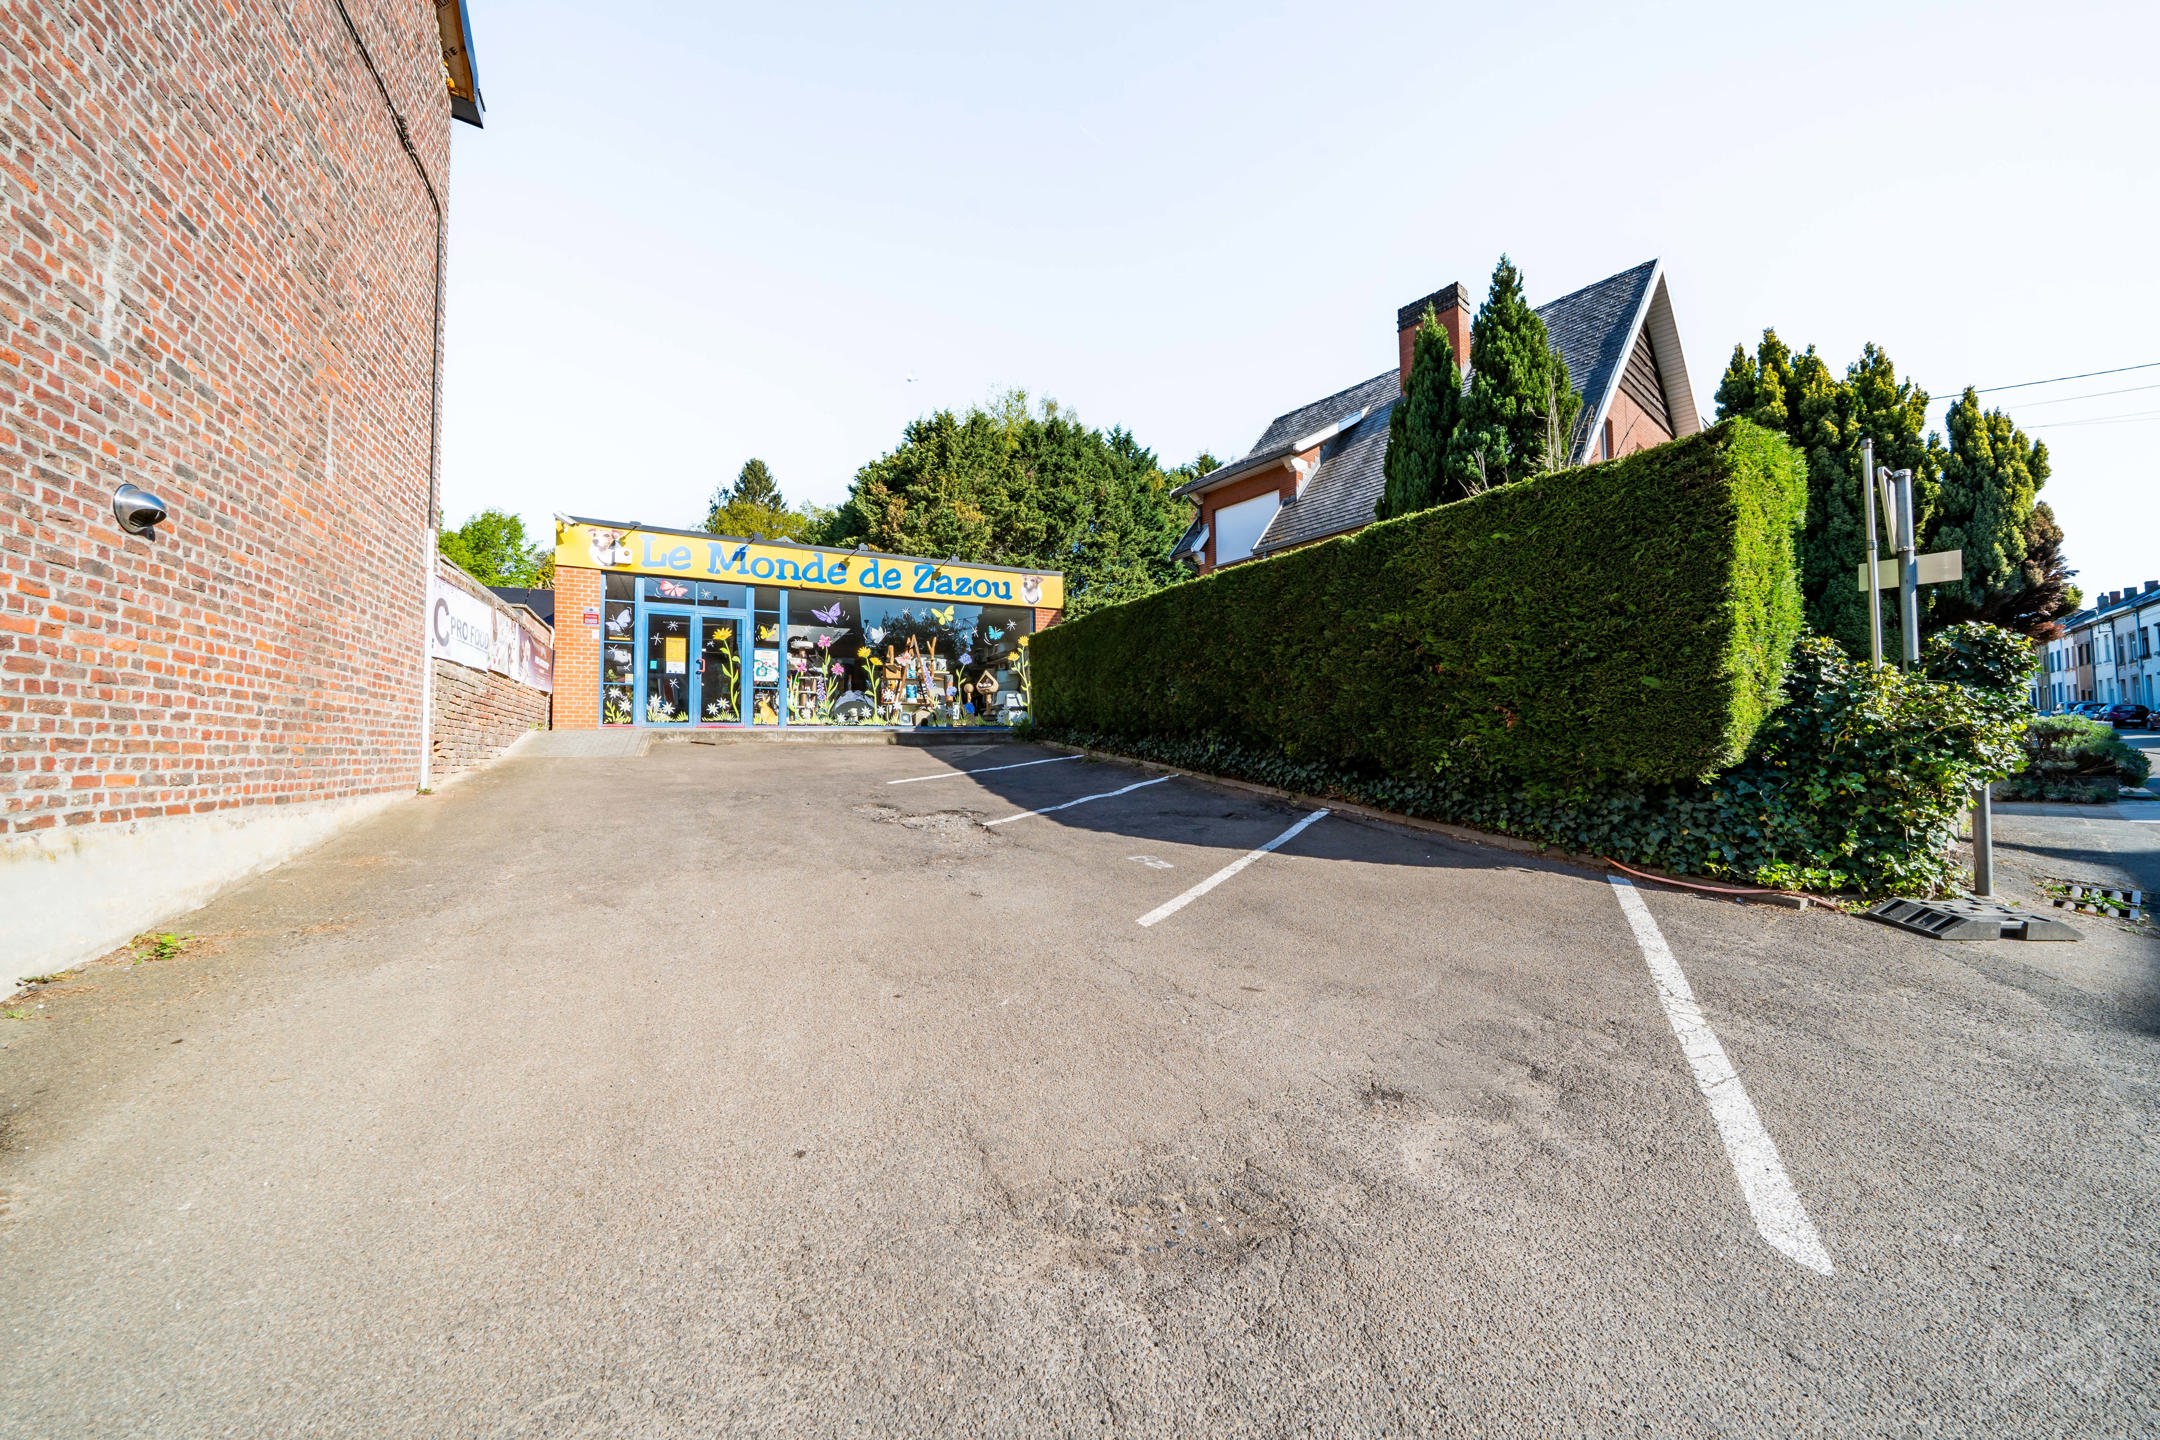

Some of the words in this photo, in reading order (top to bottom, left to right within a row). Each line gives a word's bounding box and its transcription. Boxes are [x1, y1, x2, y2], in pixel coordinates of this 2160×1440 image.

[640, 534, 691, 570] Le
[707, 542, 847, 585] Monde
[859, 559, 901, 590] de
[913, 564, 1013, 600] Zazou
[450, 615, 469, 641] PRO
[470, 625, 490, 650] FOOD
